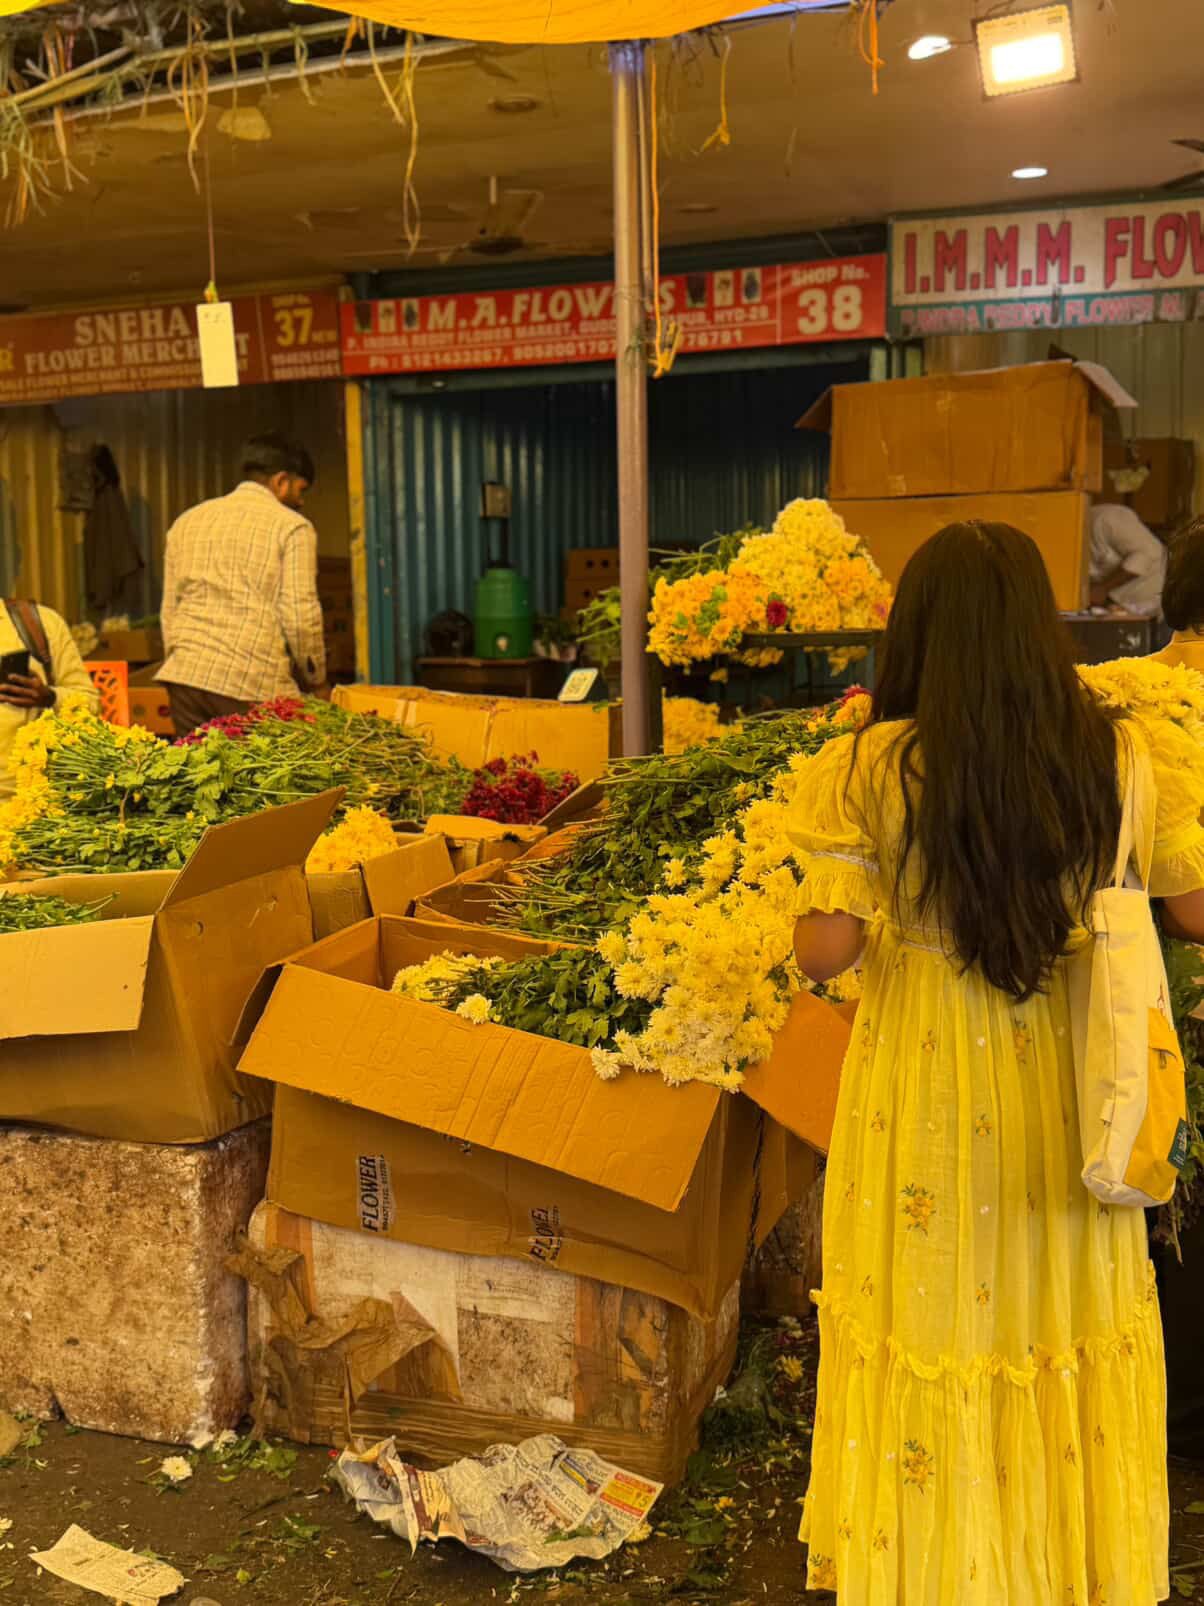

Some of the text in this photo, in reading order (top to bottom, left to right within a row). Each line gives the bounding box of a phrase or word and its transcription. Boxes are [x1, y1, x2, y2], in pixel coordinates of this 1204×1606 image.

[792, 266, 838, 287] SHOP
[904, 221, 1085, 294] I.M.M.M.
[74, 305, 191, 346] SNEHA
[274, 307, 314, 347] 37
[797, 285, 863, 335] 38
[24, 345, 116, 374] FLOWER
[121, 332, 249, 366] MERCHT
[359, 1155, 379, 1233] FLOWER
